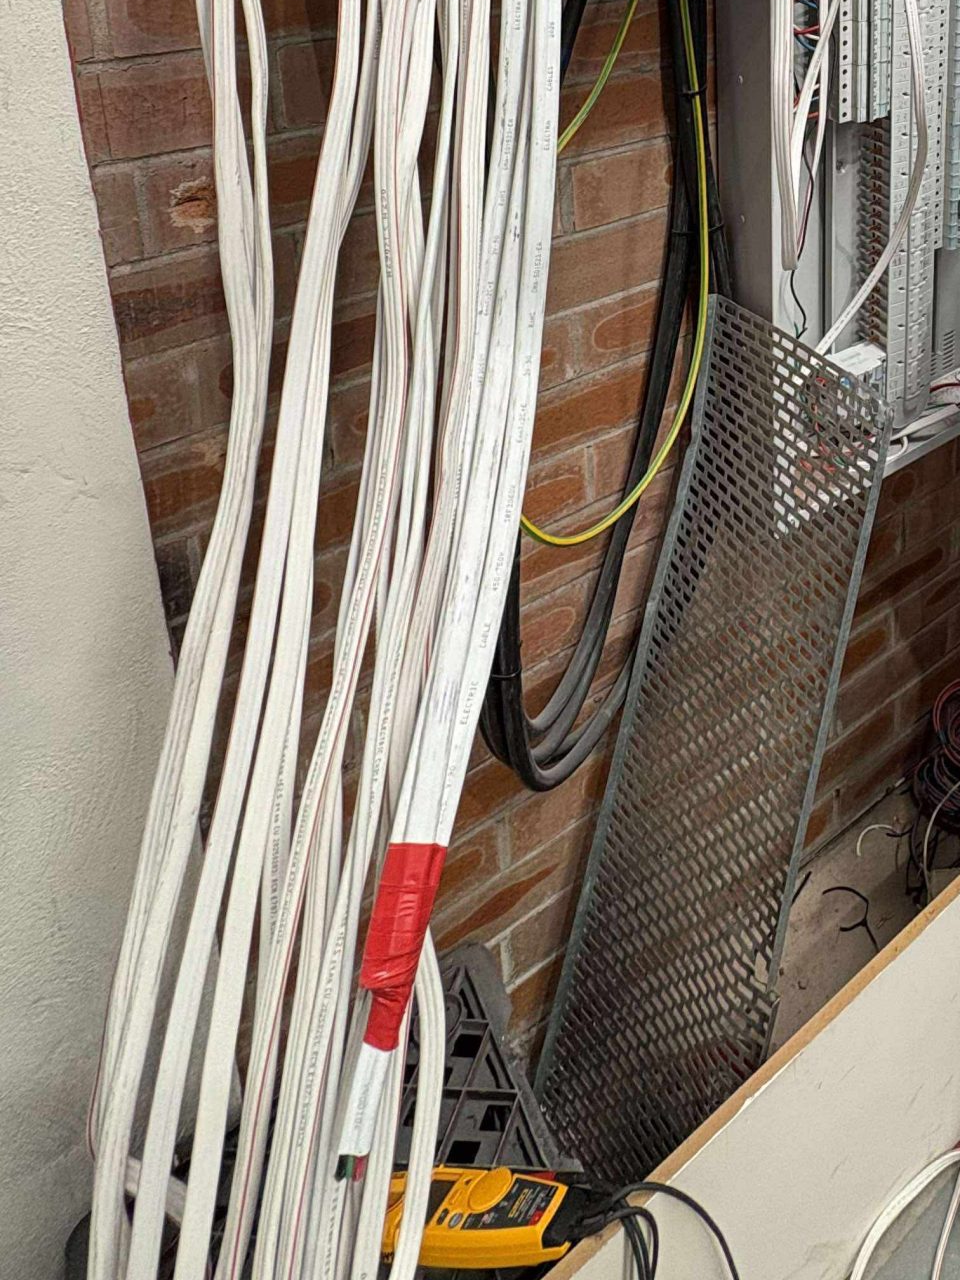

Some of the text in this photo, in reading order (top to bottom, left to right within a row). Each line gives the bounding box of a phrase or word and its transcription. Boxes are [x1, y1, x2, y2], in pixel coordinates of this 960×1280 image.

[459, 680, 480, 725] ELECTRIC
[479, 622, 491, 649] CABLE
[543, 120, 552, 152] ELECTRA
